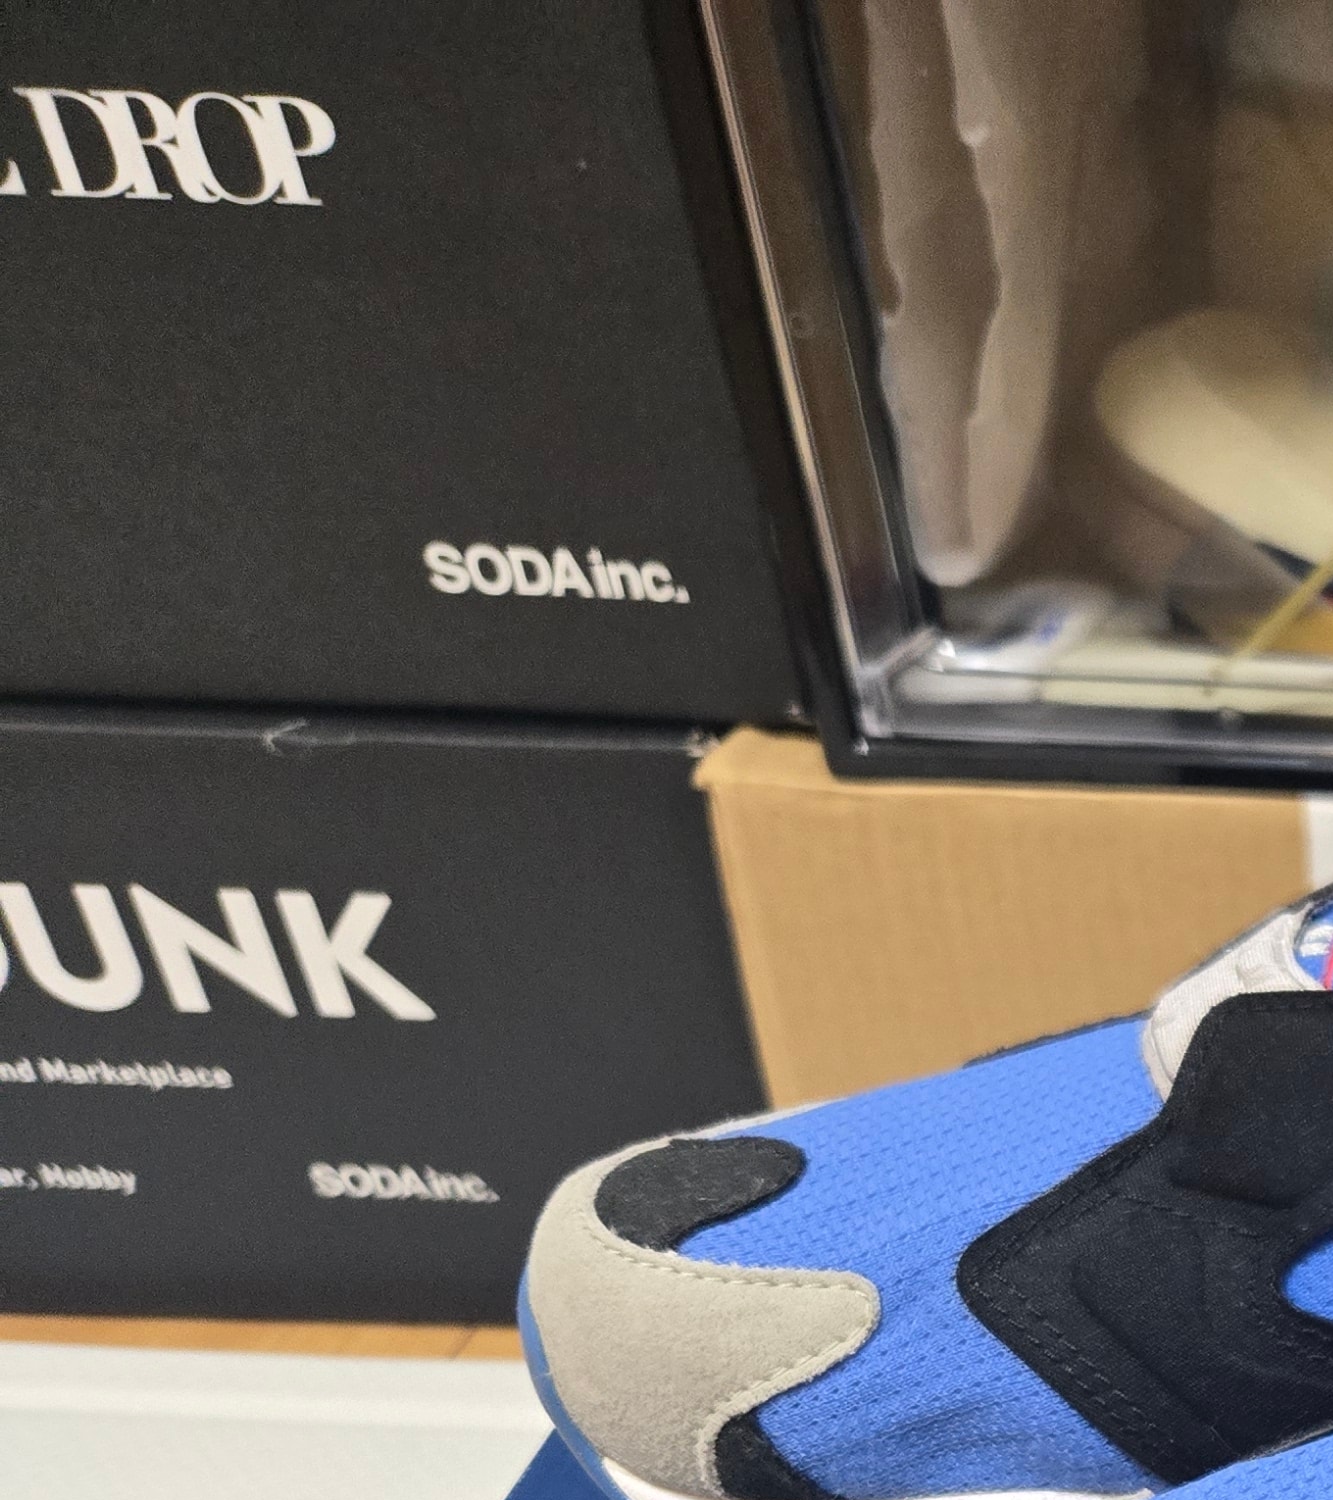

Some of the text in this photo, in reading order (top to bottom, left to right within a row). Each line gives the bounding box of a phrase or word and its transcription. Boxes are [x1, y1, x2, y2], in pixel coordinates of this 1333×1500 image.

[13, 85, 337, 206] DROP
[0, 880, 436, 1022] UNK
[0, 1057, 234, 1092] nd Marketplace
[0, 1163, 137, 1197] ar, Hobby
